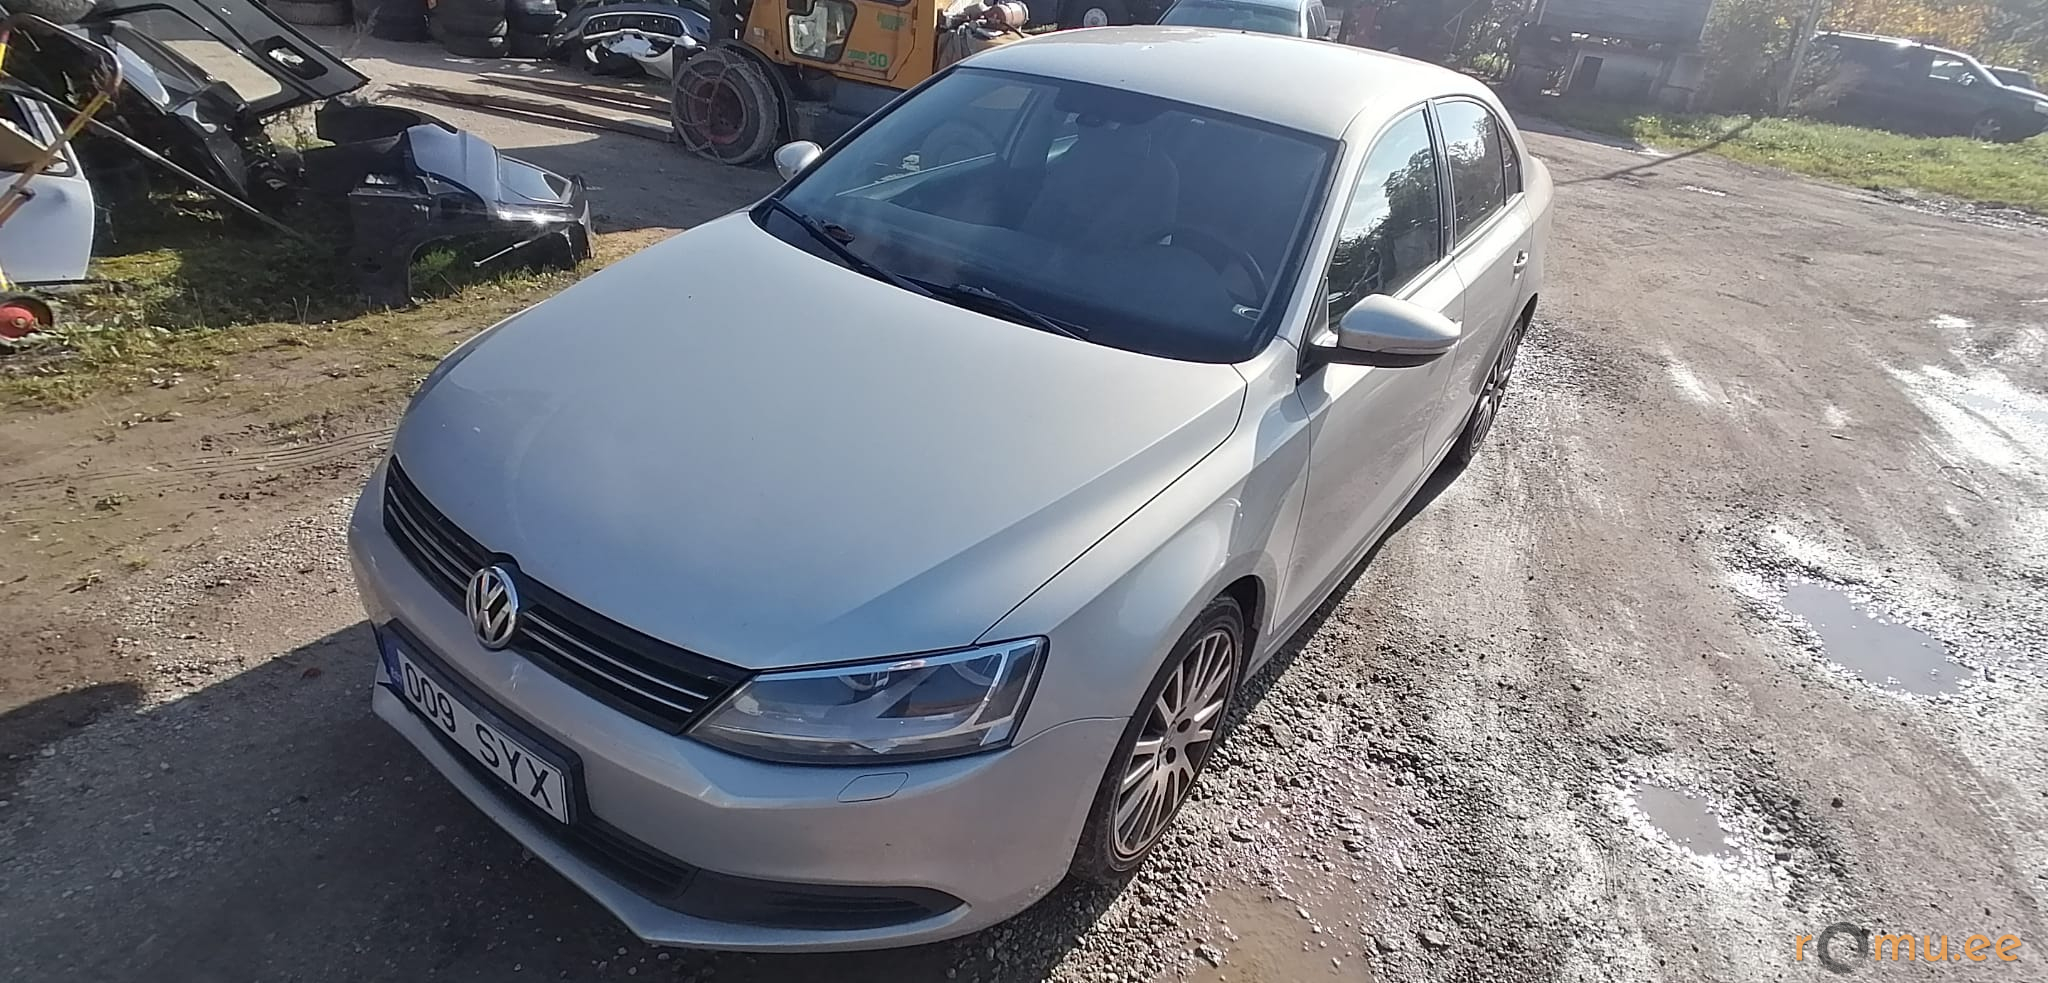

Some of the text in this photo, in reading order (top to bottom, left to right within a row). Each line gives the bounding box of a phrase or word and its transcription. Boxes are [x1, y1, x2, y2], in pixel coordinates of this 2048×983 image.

[868, 51, 888, 68] 30
[404, 662, 553, 810] 009 SYX
